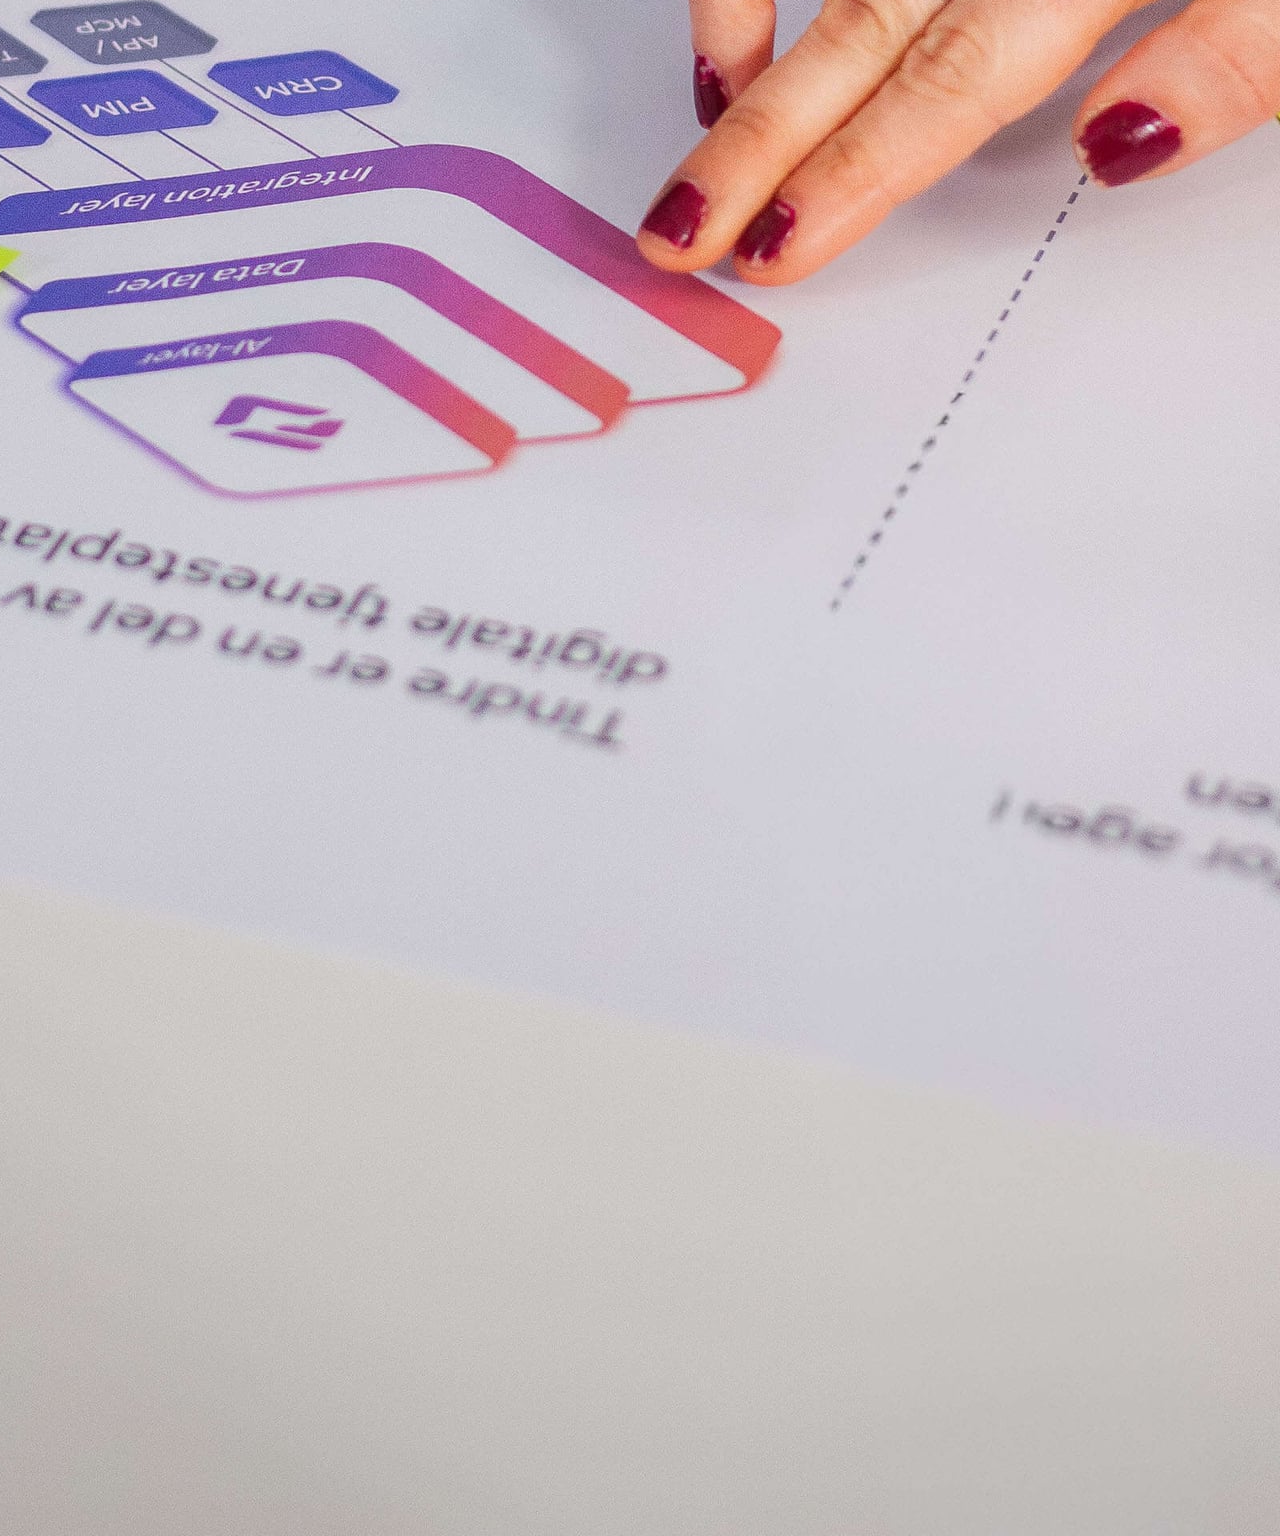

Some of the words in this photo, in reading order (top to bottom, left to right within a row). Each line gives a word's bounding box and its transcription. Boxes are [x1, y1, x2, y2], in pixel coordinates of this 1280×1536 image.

[75, 14, 143, 35] MCP
[112, 34, 159, 53] API
[253, 75, 343, 100] CRM
[81, 96, 157, 119] PIM
[163, 165, 374, 204] Integration
[60, 192, 158, 216] layer
[107, 270, 199, 294] layer
[212, 258, 306, 281] Data
[142, 335, 273, 365] AI-layer
[88, 598, 202, 648] del
[217, 625, 304, 664] en
[409, 604, 671, 688] digitale
[315, 649, 391, 683] er
[406, 666, 626, 751] Tindre
